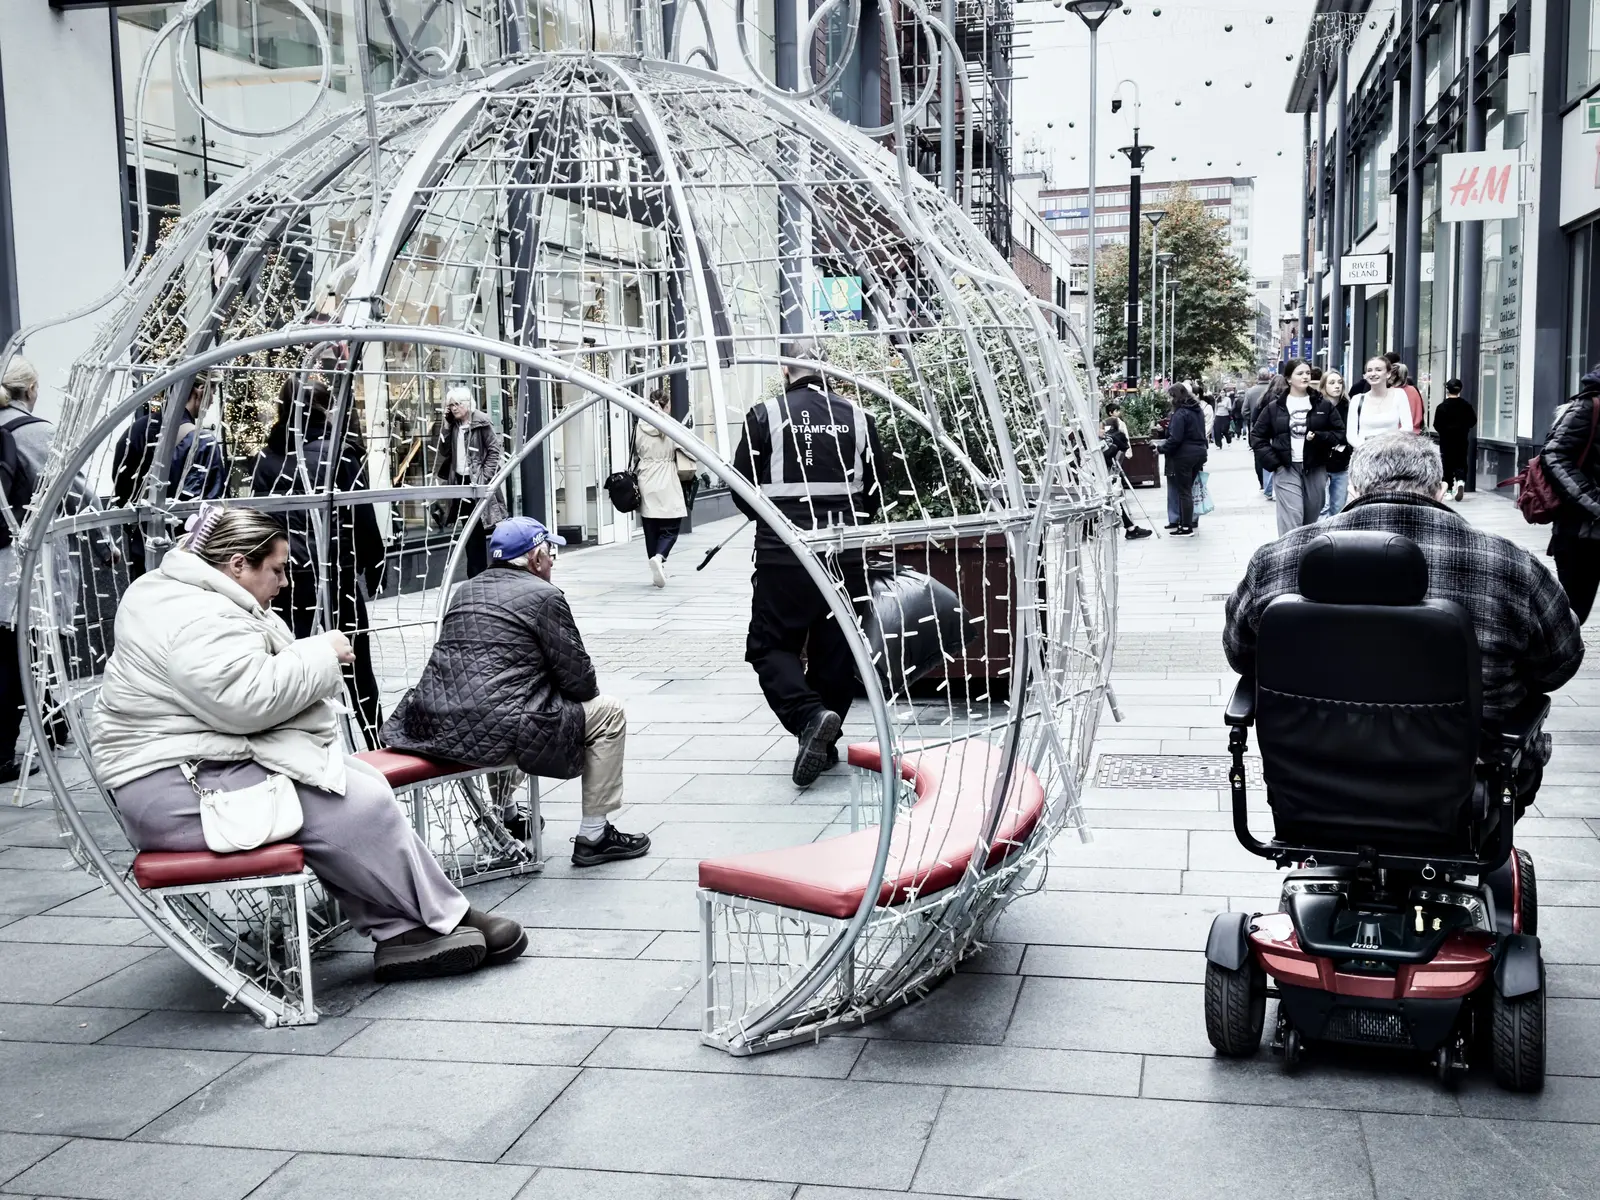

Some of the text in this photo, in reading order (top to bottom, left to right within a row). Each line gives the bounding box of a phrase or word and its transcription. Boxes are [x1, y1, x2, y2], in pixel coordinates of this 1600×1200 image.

[1450, 164, 1511, 206] H&M
[1352, 261, 1375, 269] RIVER
[1348, 269, 1379, 278] ISLAND
[791, 423, 850, 434] STAMFORD
[801, 410, 813, 466] QUARTER
[1351, 942, 1379, 950] Pride
